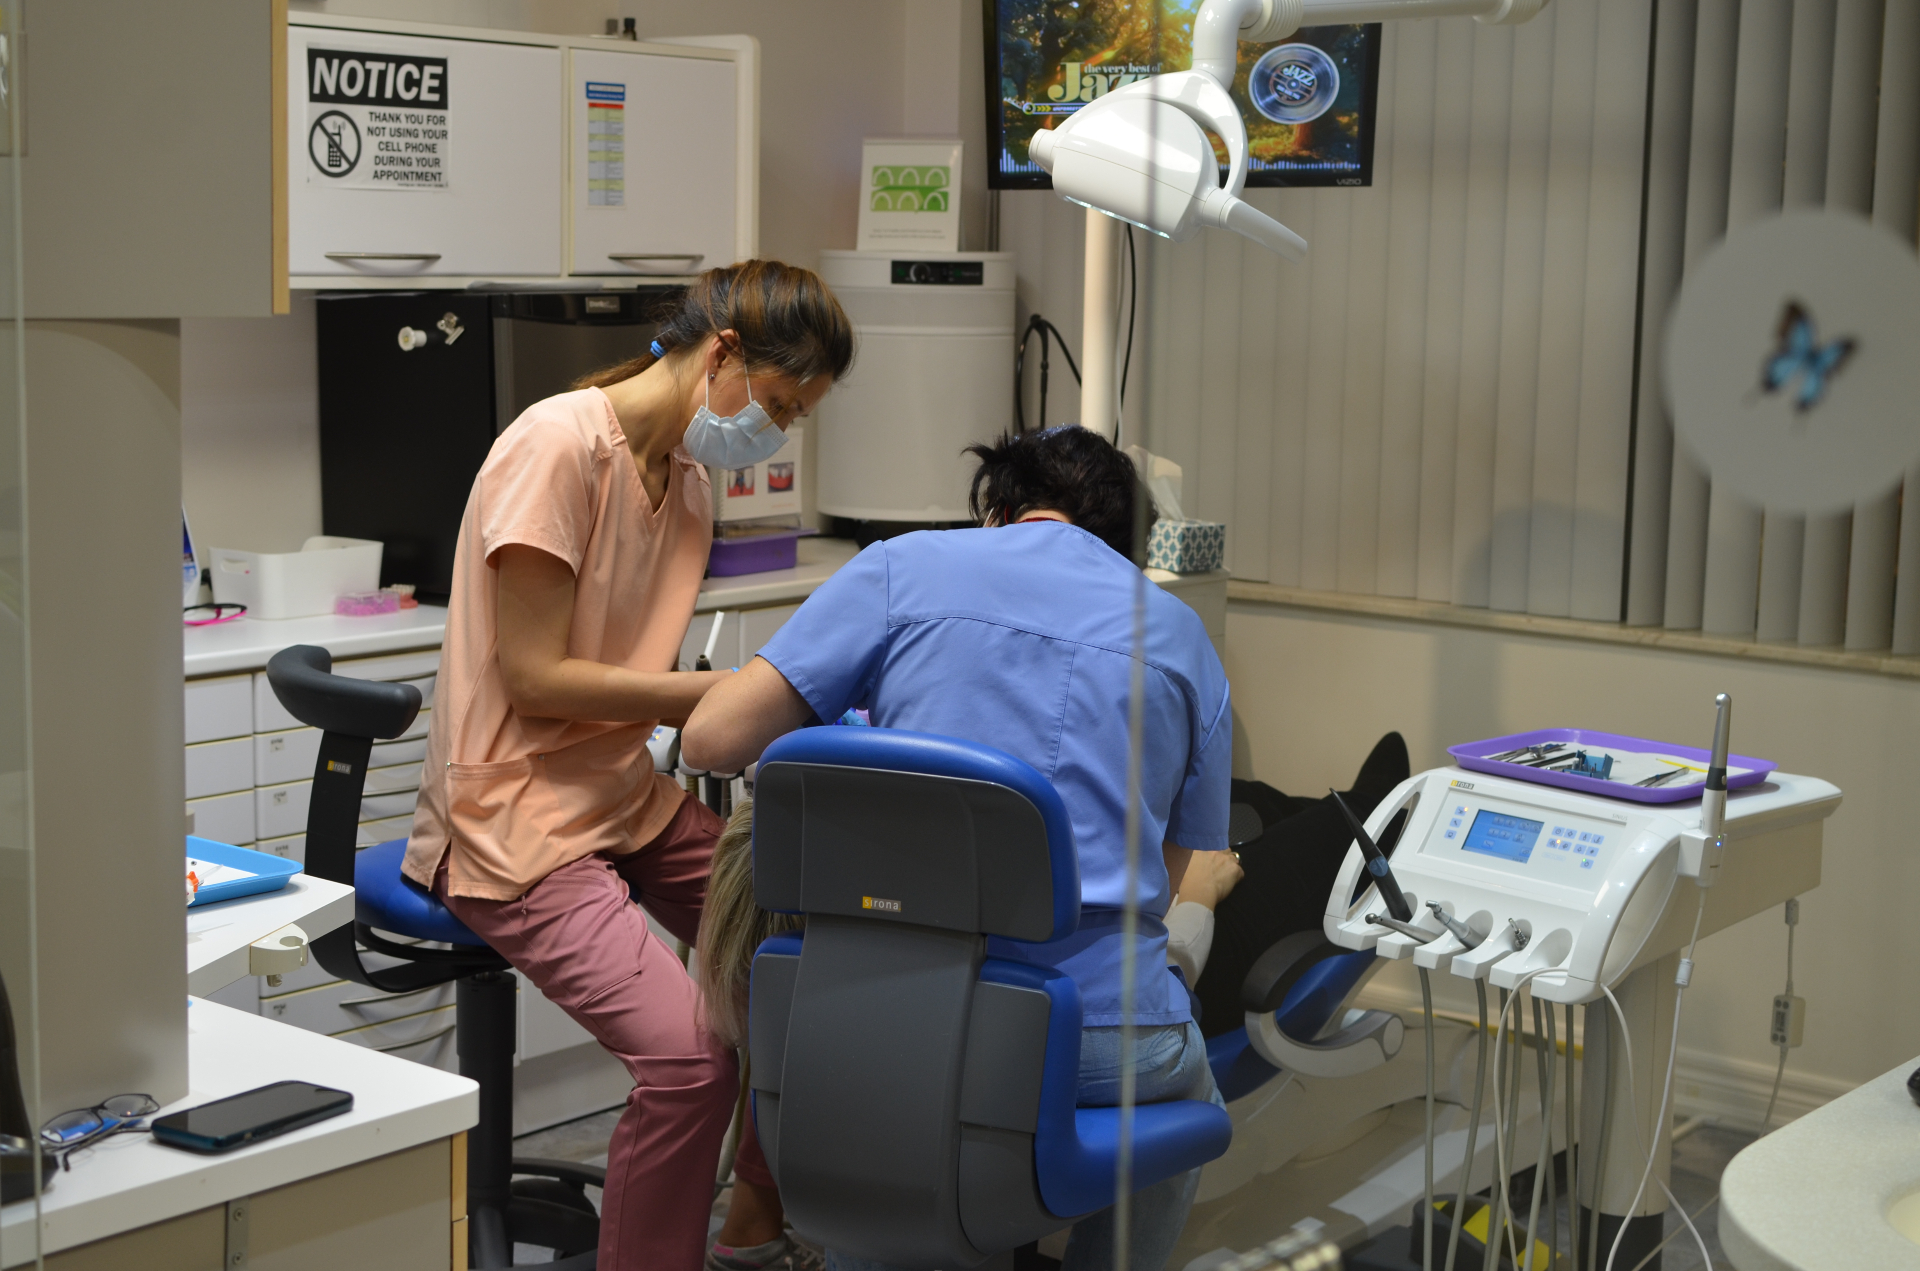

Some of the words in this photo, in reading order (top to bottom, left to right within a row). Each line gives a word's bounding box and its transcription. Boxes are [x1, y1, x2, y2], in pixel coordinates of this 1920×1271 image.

[1084, 63, 1101, 74] the
[1103, 65, 1128, 75] very
[1128, 63, 1150, 74] best
[1151, 62, 1163, 73] of
[313, 57, 443, 102] NOTICE
[1047, 62, 1158, 102] Jaz
[1283, 64, 1316, 87] JAZZ
[369, 112, 402, 124] THANK
[404, 113, 424, 125] YOU
[426, 115, 446, 126] FOR
[367, 126, 386, 137] NOT
[389, 127, 419, 138] USING
[421, 129, 448, 140] YOUR
[378, 141, 402, 152] CELL
[405, 142, 437, 154] PHONE
[374, 155, 413, 167] DURING
[415, 157, 441, 168] YOUR
[373, 169, 442, 182] APPOINTMENT
[1336, 177, 1362, 186] VIZIO
[864, 898, 900, 910] sirona
